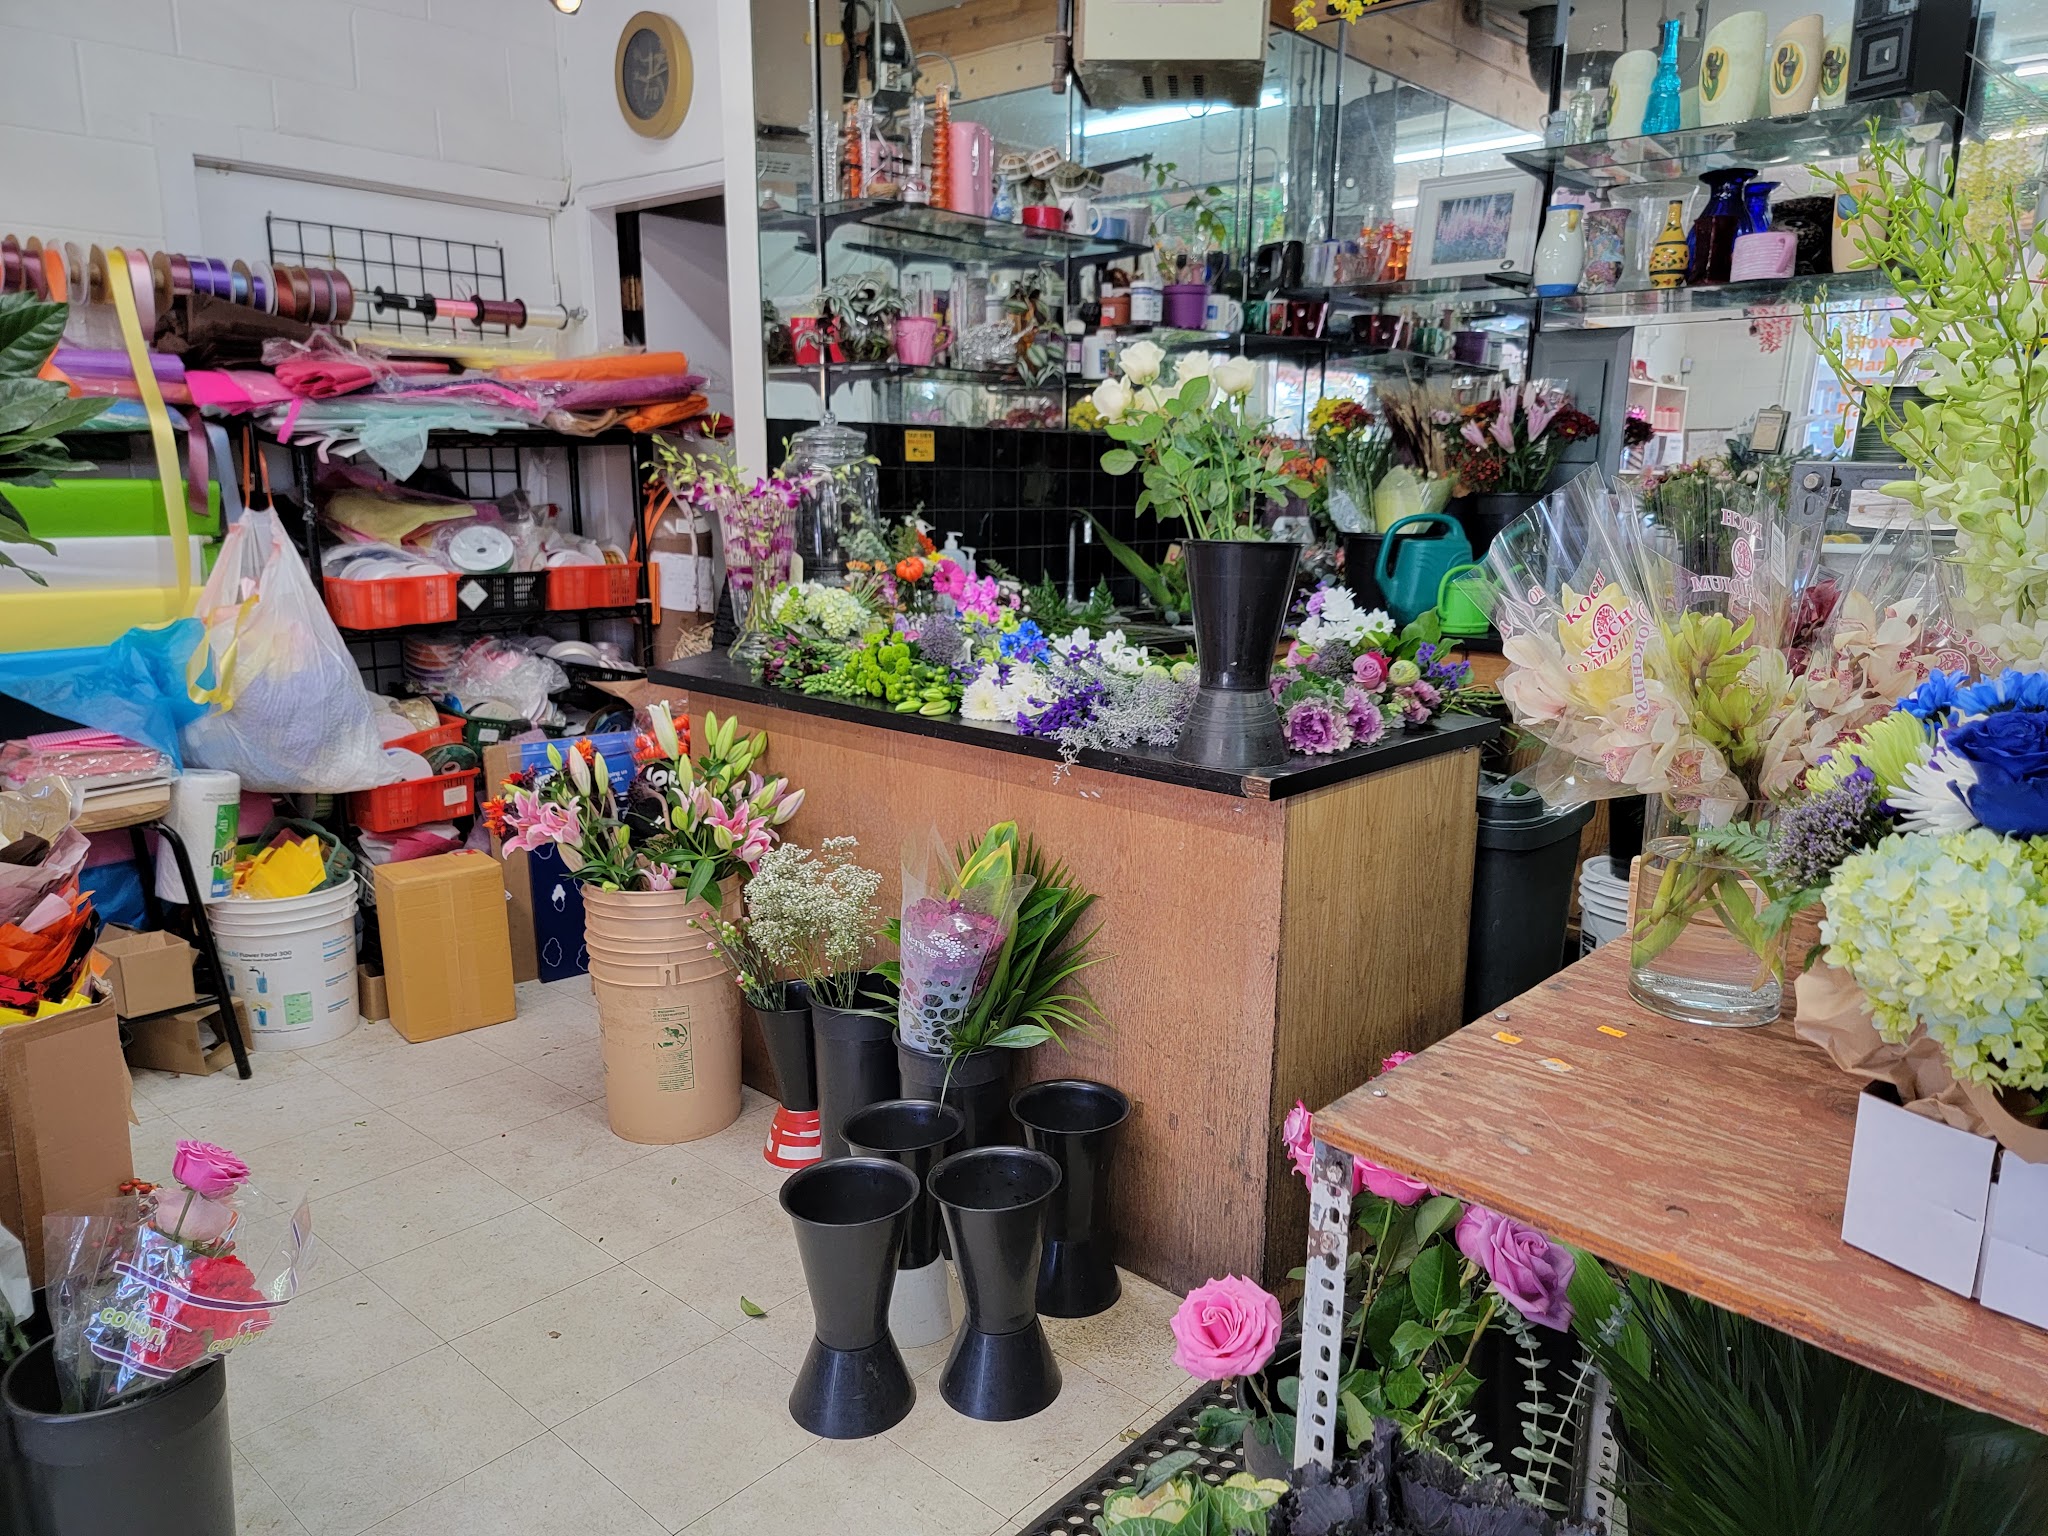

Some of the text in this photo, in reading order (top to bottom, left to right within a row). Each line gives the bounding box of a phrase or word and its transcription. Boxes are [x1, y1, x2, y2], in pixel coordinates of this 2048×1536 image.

[1565, 567, 1606, 626] KOCH
[1582, 608, 1637, 659] KOCH
[903, 928, 943, 959] Heritage
